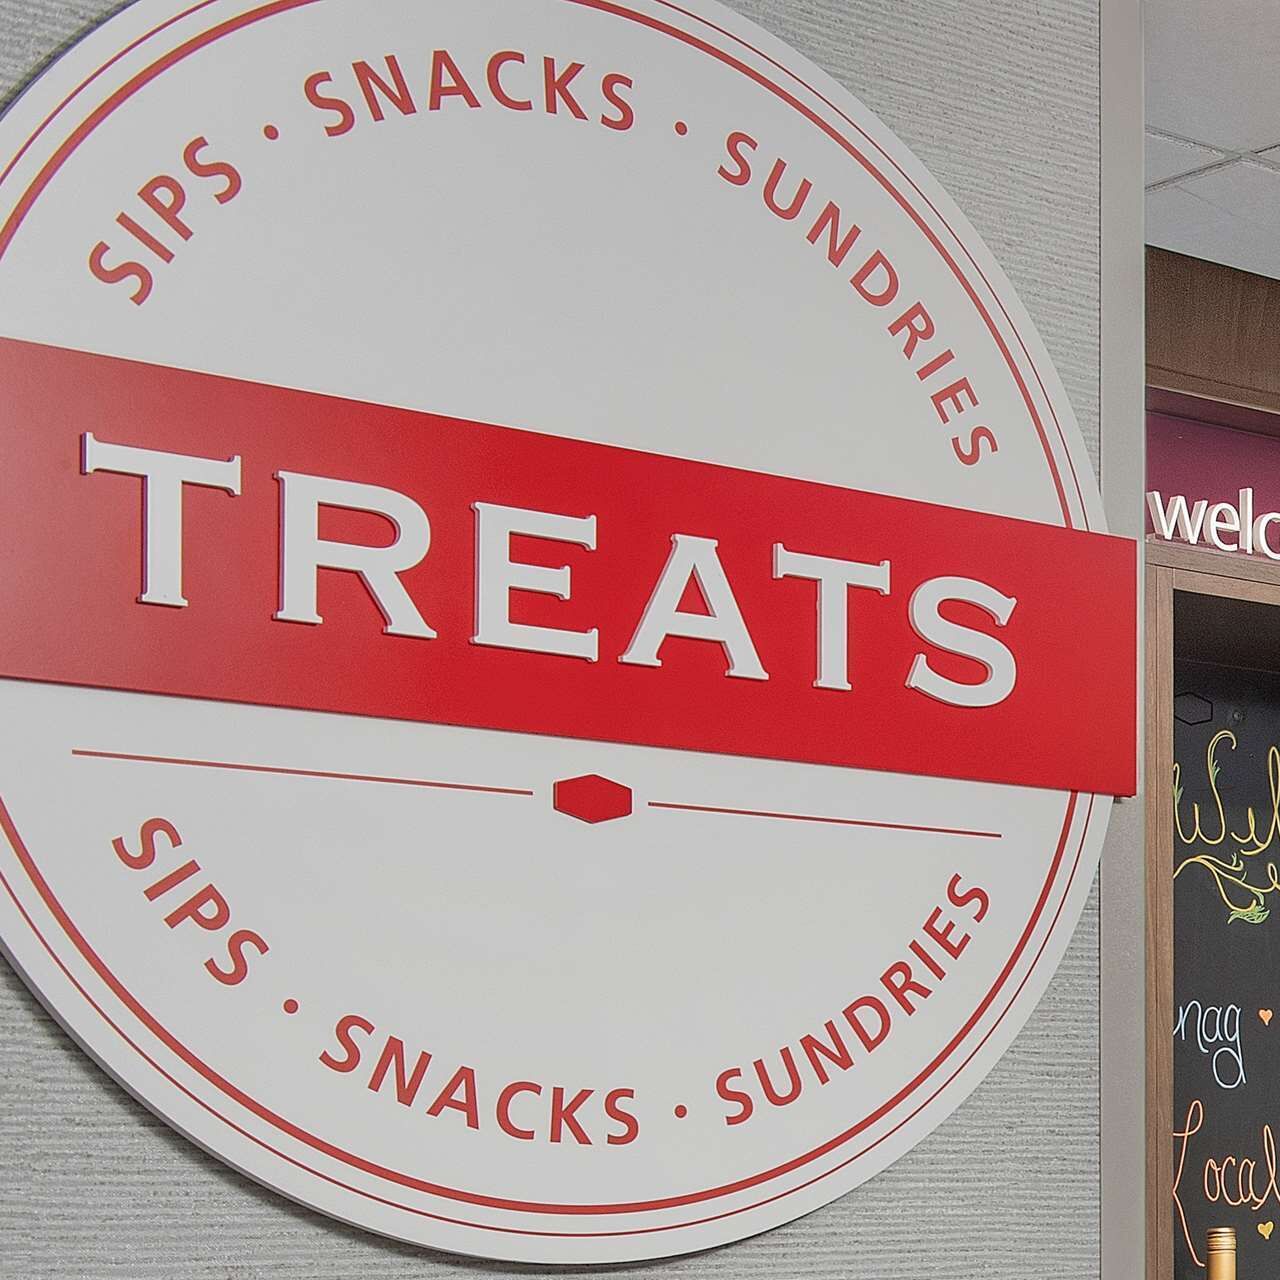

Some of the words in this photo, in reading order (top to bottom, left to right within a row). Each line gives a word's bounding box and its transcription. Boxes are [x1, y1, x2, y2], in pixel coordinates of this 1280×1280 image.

[88, 135, 244, 305] SIPS
[304, 49, 636, 138] SNACKS
[718, 131, 999, 470] SUNDRIES
[81, 432, 1018, 709] TREATS
[111, 816, 270, 988] SIPS
[319, 1013, 640, 1147] SNACKS
[716, 874, 991, 1126] SUNDRIES
